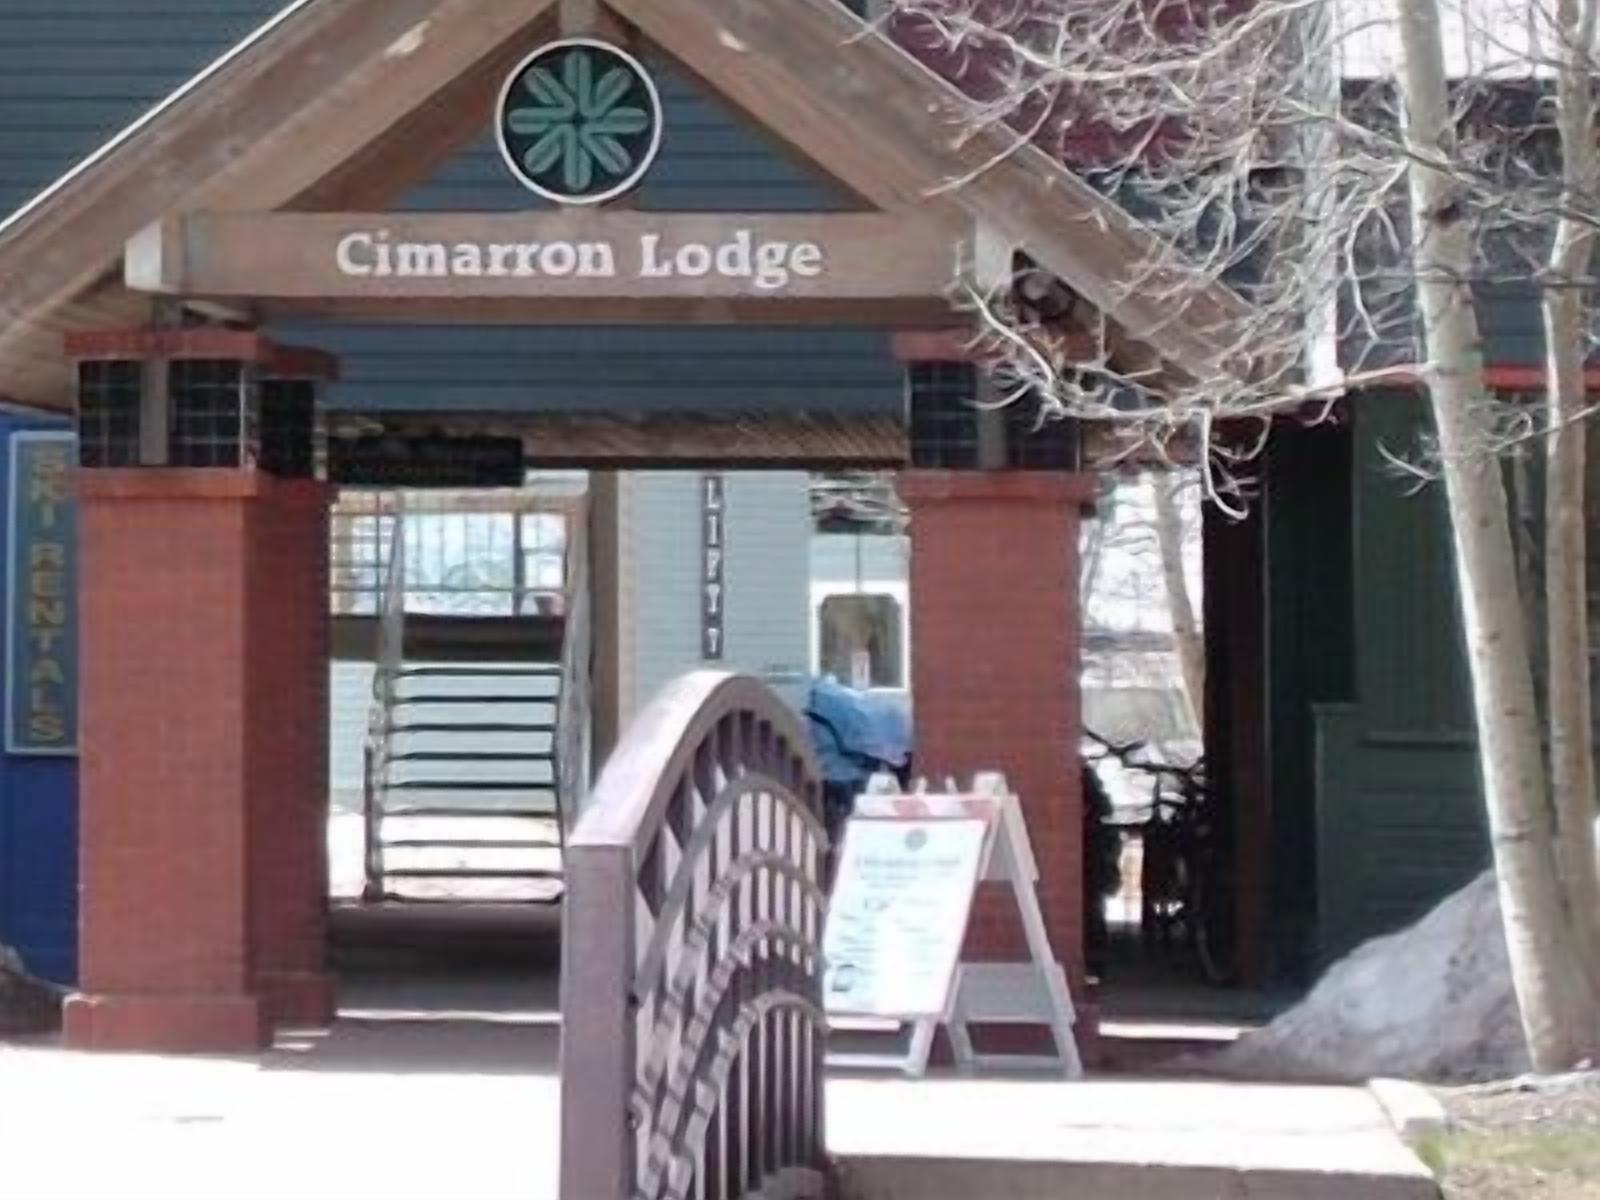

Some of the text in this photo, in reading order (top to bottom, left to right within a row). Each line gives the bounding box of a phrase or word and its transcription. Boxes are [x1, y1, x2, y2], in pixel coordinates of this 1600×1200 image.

[335, 229, 823, 289] Cimarron Lodge
[30, 541, 65, 742] RENTALS
